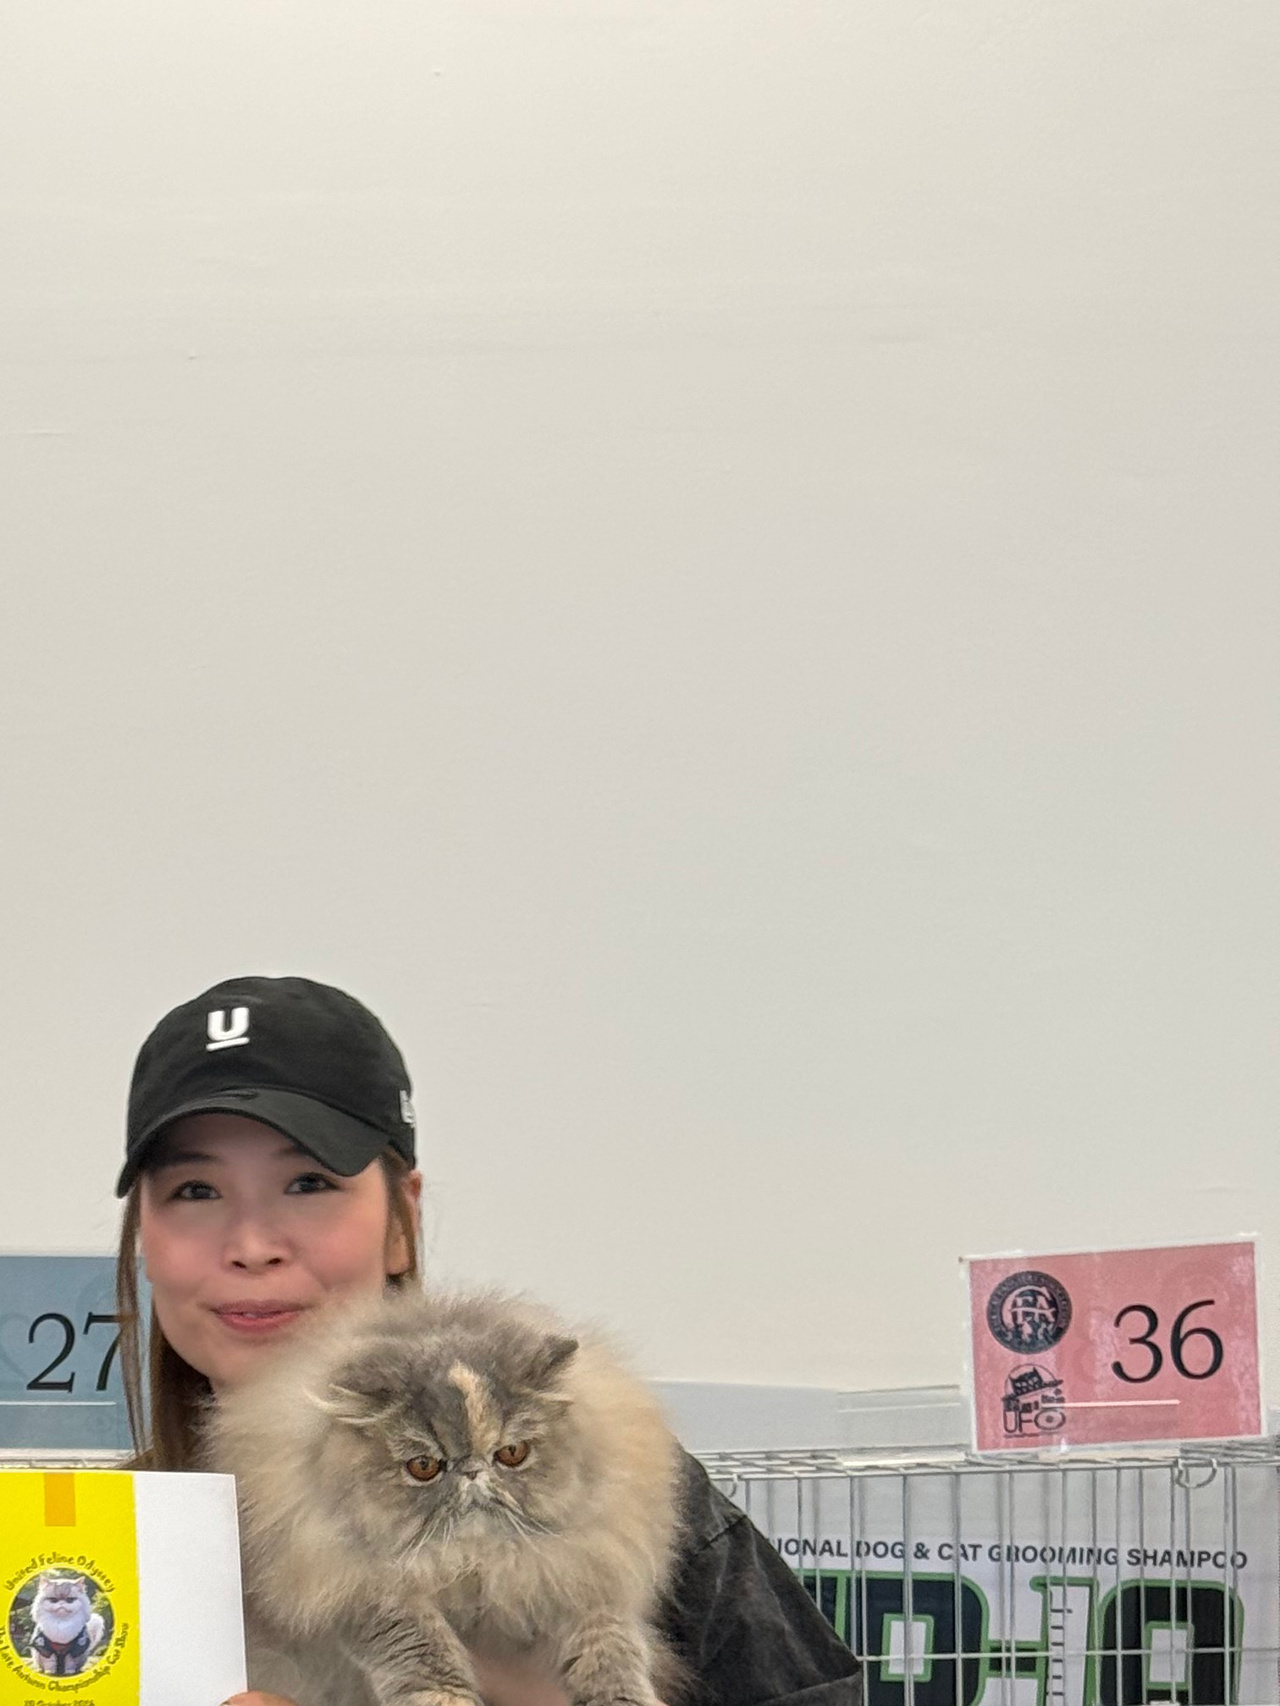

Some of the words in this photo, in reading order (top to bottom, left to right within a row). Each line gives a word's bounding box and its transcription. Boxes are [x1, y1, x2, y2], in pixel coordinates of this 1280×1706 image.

[207, 1006, 250, 1042] U
[26, 1312, 123, 1393] 27
[1111, 1299, 1224, 1383] 36
[856, 1540, 906, 1559] DOG
[913, 1543, 930, 1560] &
[938, 1543, 982, 1562] CAT
[987, 1545, 1118, 1566] GROOMING
[1126, 1548, 1248, 1569] SHAMPOO
